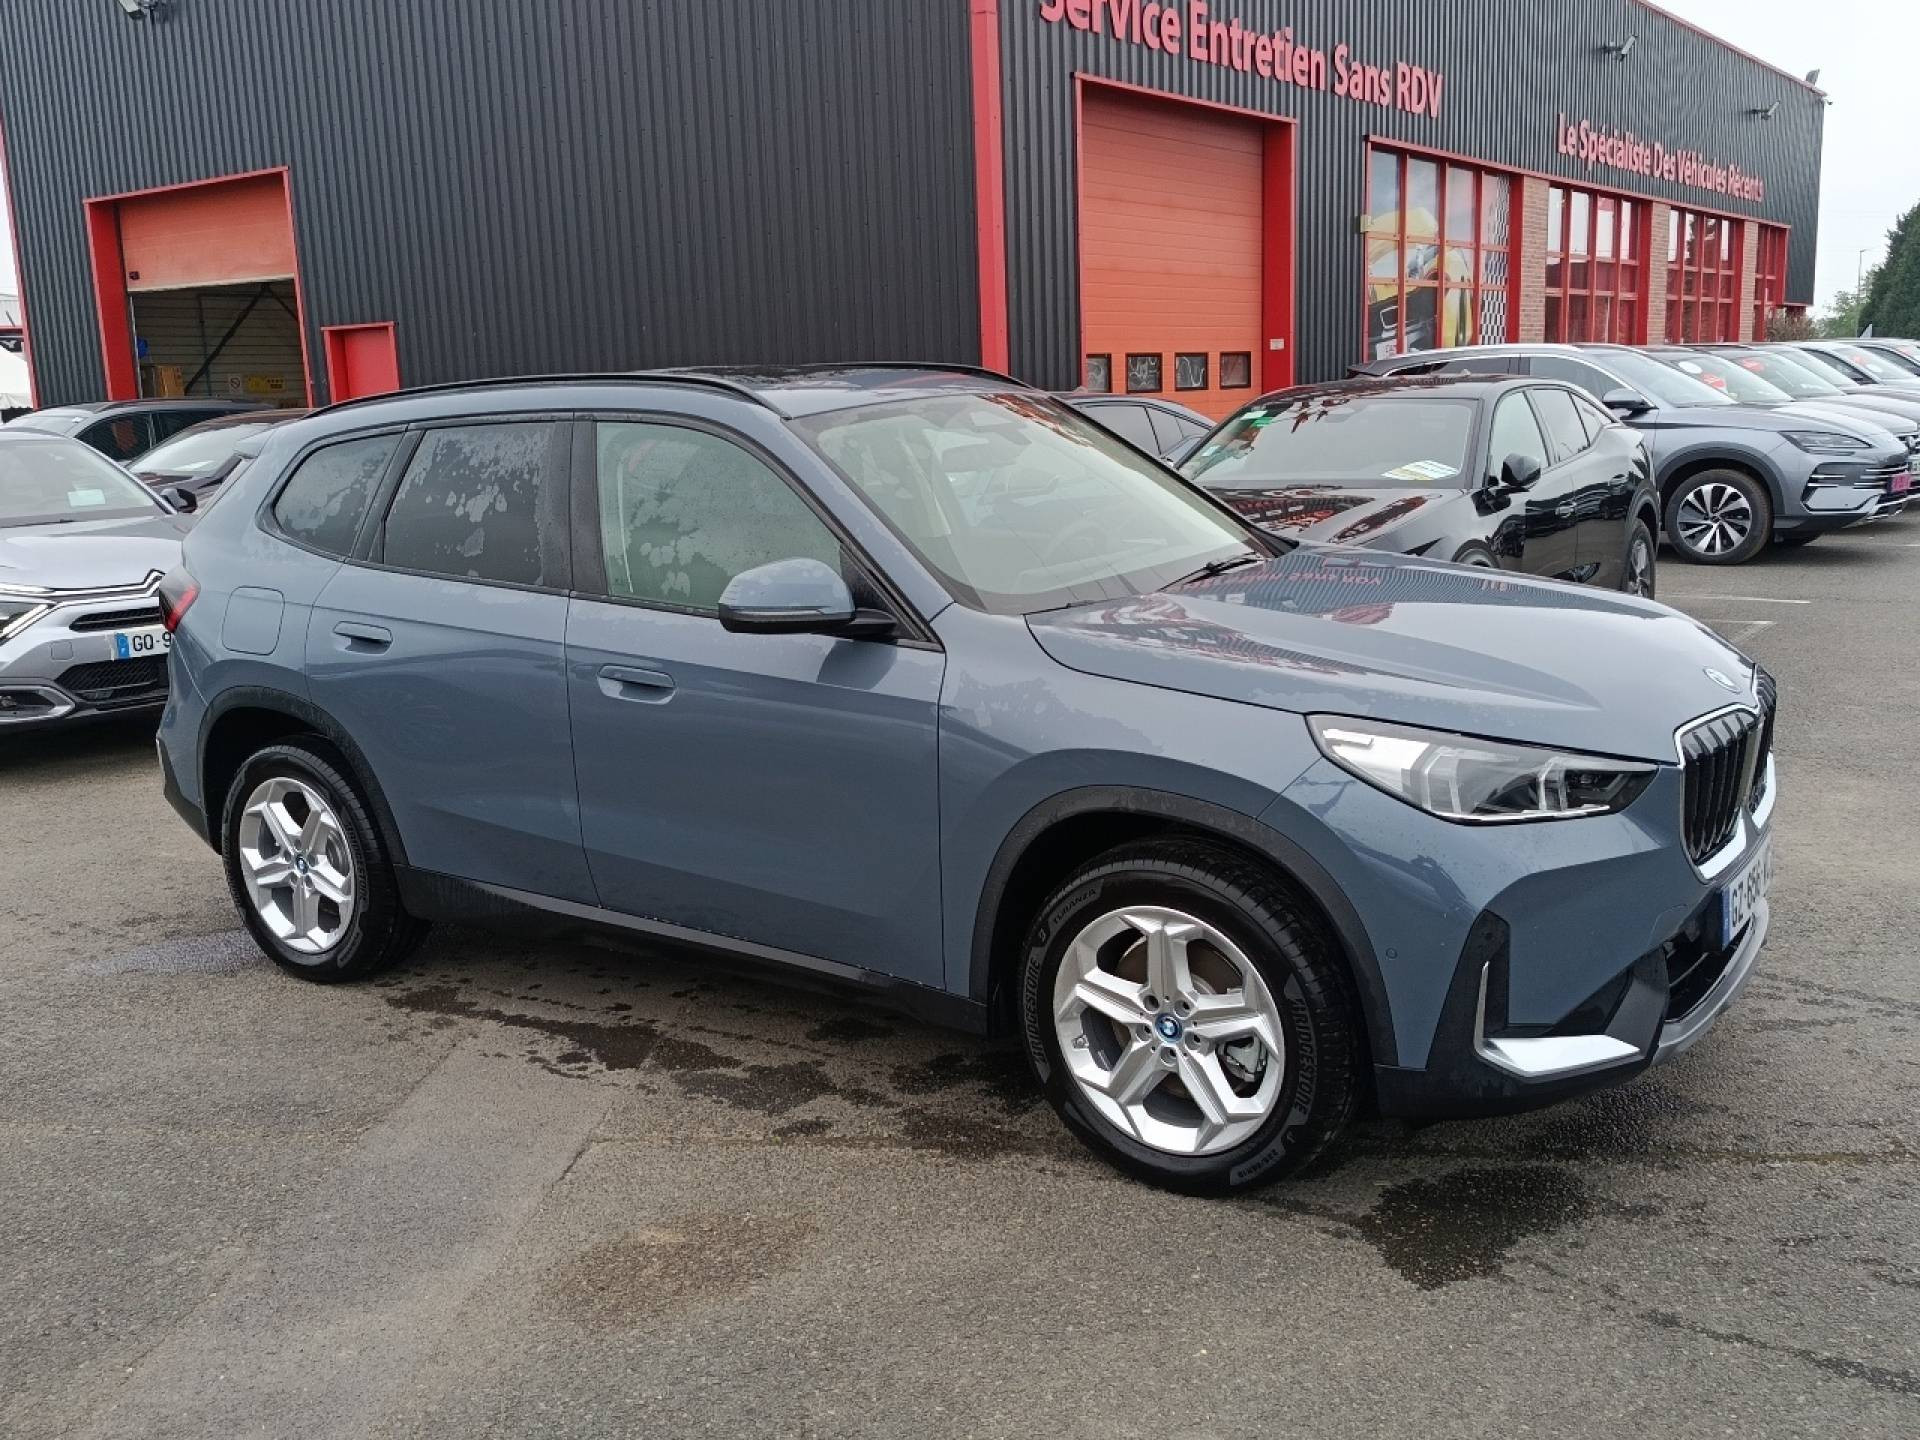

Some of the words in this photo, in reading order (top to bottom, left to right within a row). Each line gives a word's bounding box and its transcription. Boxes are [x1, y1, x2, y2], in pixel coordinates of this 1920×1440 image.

[1190, 0, 1326, 90] Entretien
[1334, 43, 1390, 108] Sans
[1397, 62, 1444, 119] RDV
[1558, 113, 1577, 156] Le
[1579, 119, 1650, 176] Spécialiste
[1653, 142, 1676, 182] Des
[1677, 149, 1726, 193] Véhicules
[1728, 163, 1764, 202] Récents
